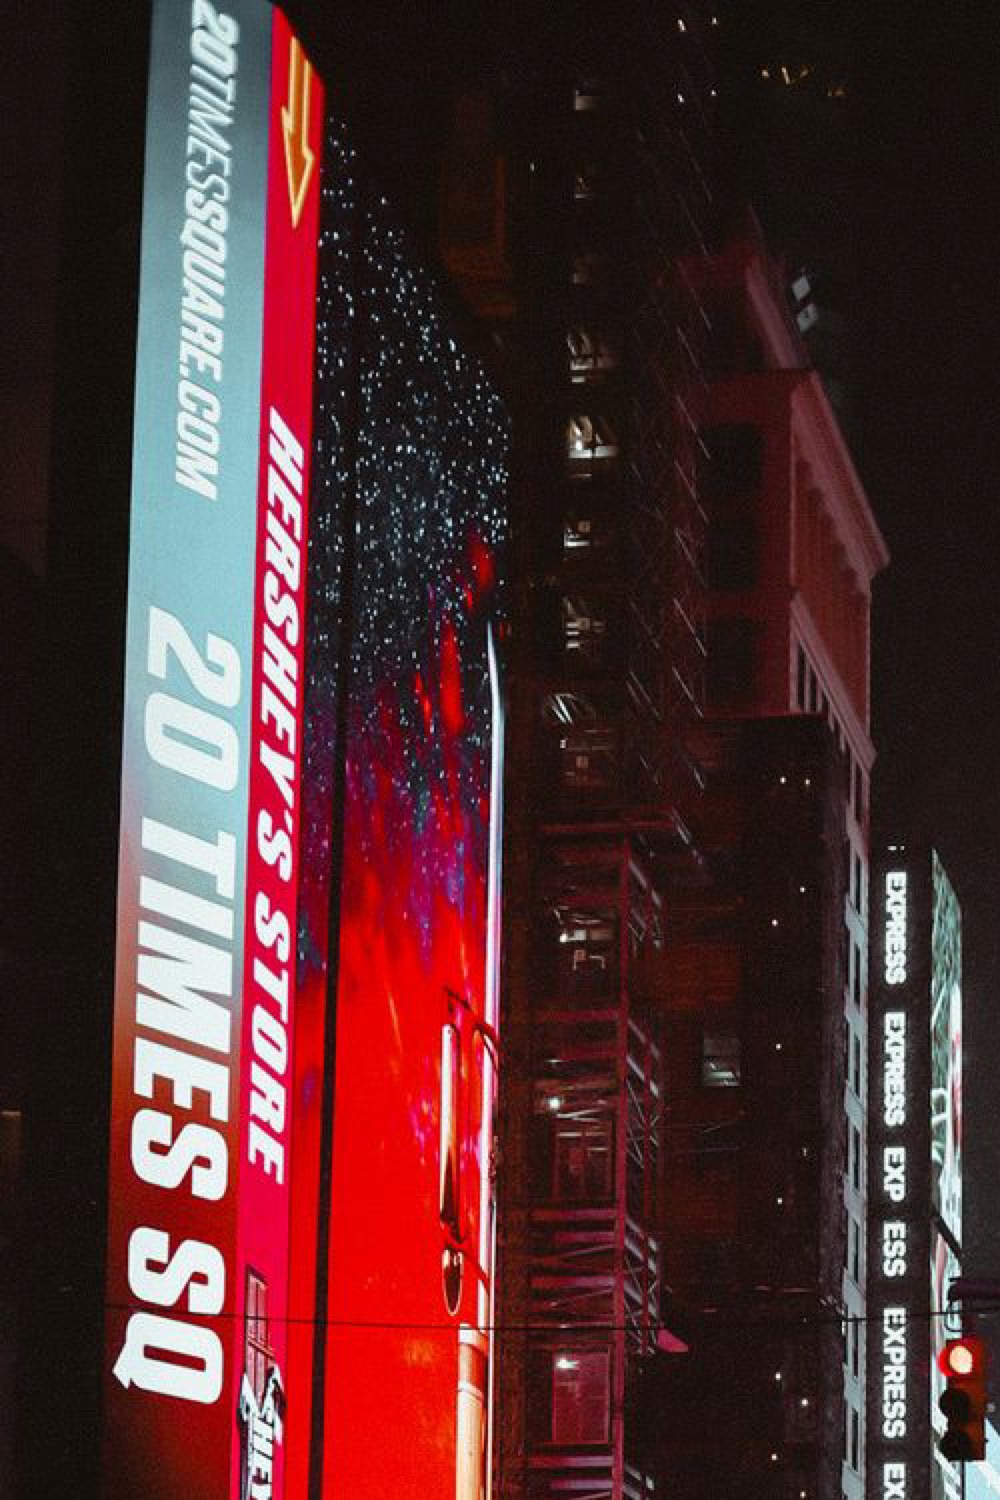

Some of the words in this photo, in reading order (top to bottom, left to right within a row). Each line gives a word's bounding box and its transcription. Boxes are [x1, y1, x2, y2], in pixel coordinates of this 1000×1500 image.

[175, 0, 240, 501] 20TIMESSQUARE.COM
[144, 605, 241, 791] 20
[256, 406, 304, 883] HERSHEY'S
[130, 815, 237, 1202] TIMES
[885, 871, 908, 985] EXPRESS
[248, 891, 293, 1184] STORE
[884, 1011, 907, 1127] EXPRESS
[112, 1226, 226, 1405] SQ
[882, 1307, 907, 1440] EXPRESS
